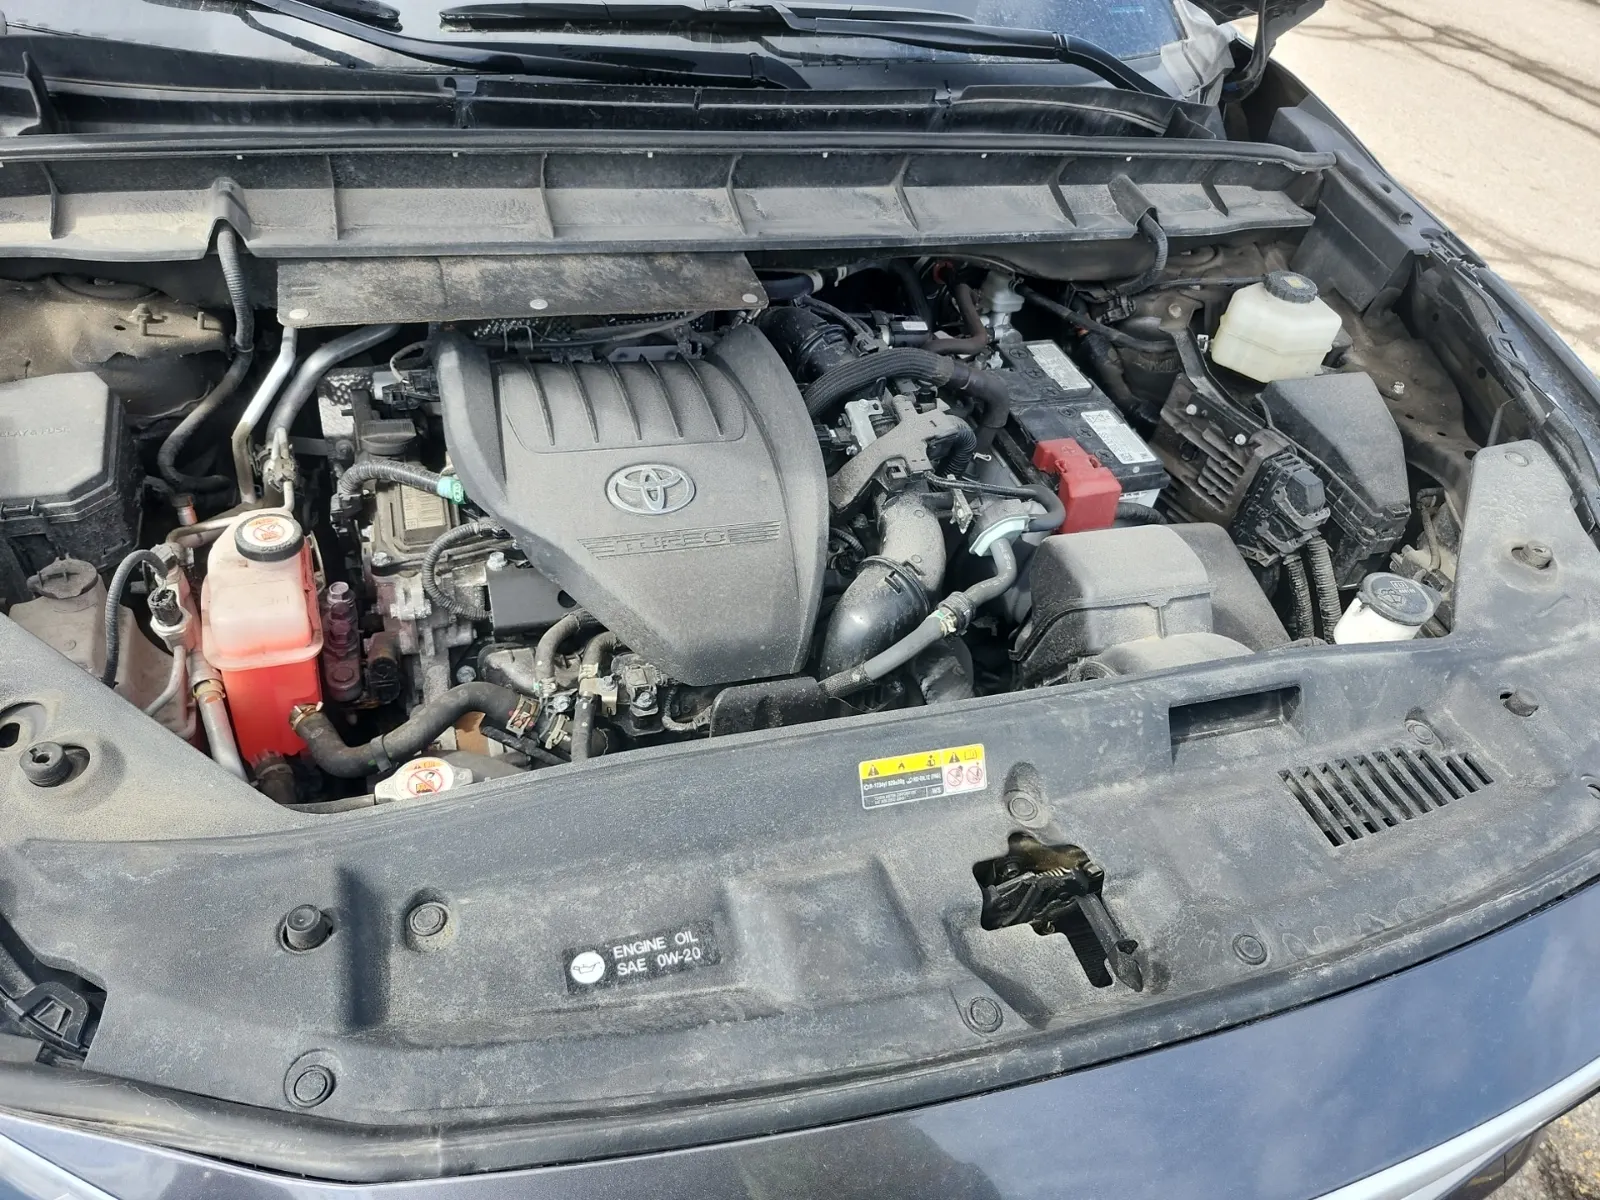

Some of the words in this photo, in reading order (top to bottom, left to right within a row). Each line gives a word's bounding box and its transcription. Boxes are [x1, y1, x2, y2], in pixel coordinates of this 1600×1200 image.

[613, 936, 666, 959] ENGINE
[675, 931, 699, 945] OIL
[617, 958, 648, 976] SAE
[657, 946, 701, 967] 0W-20
